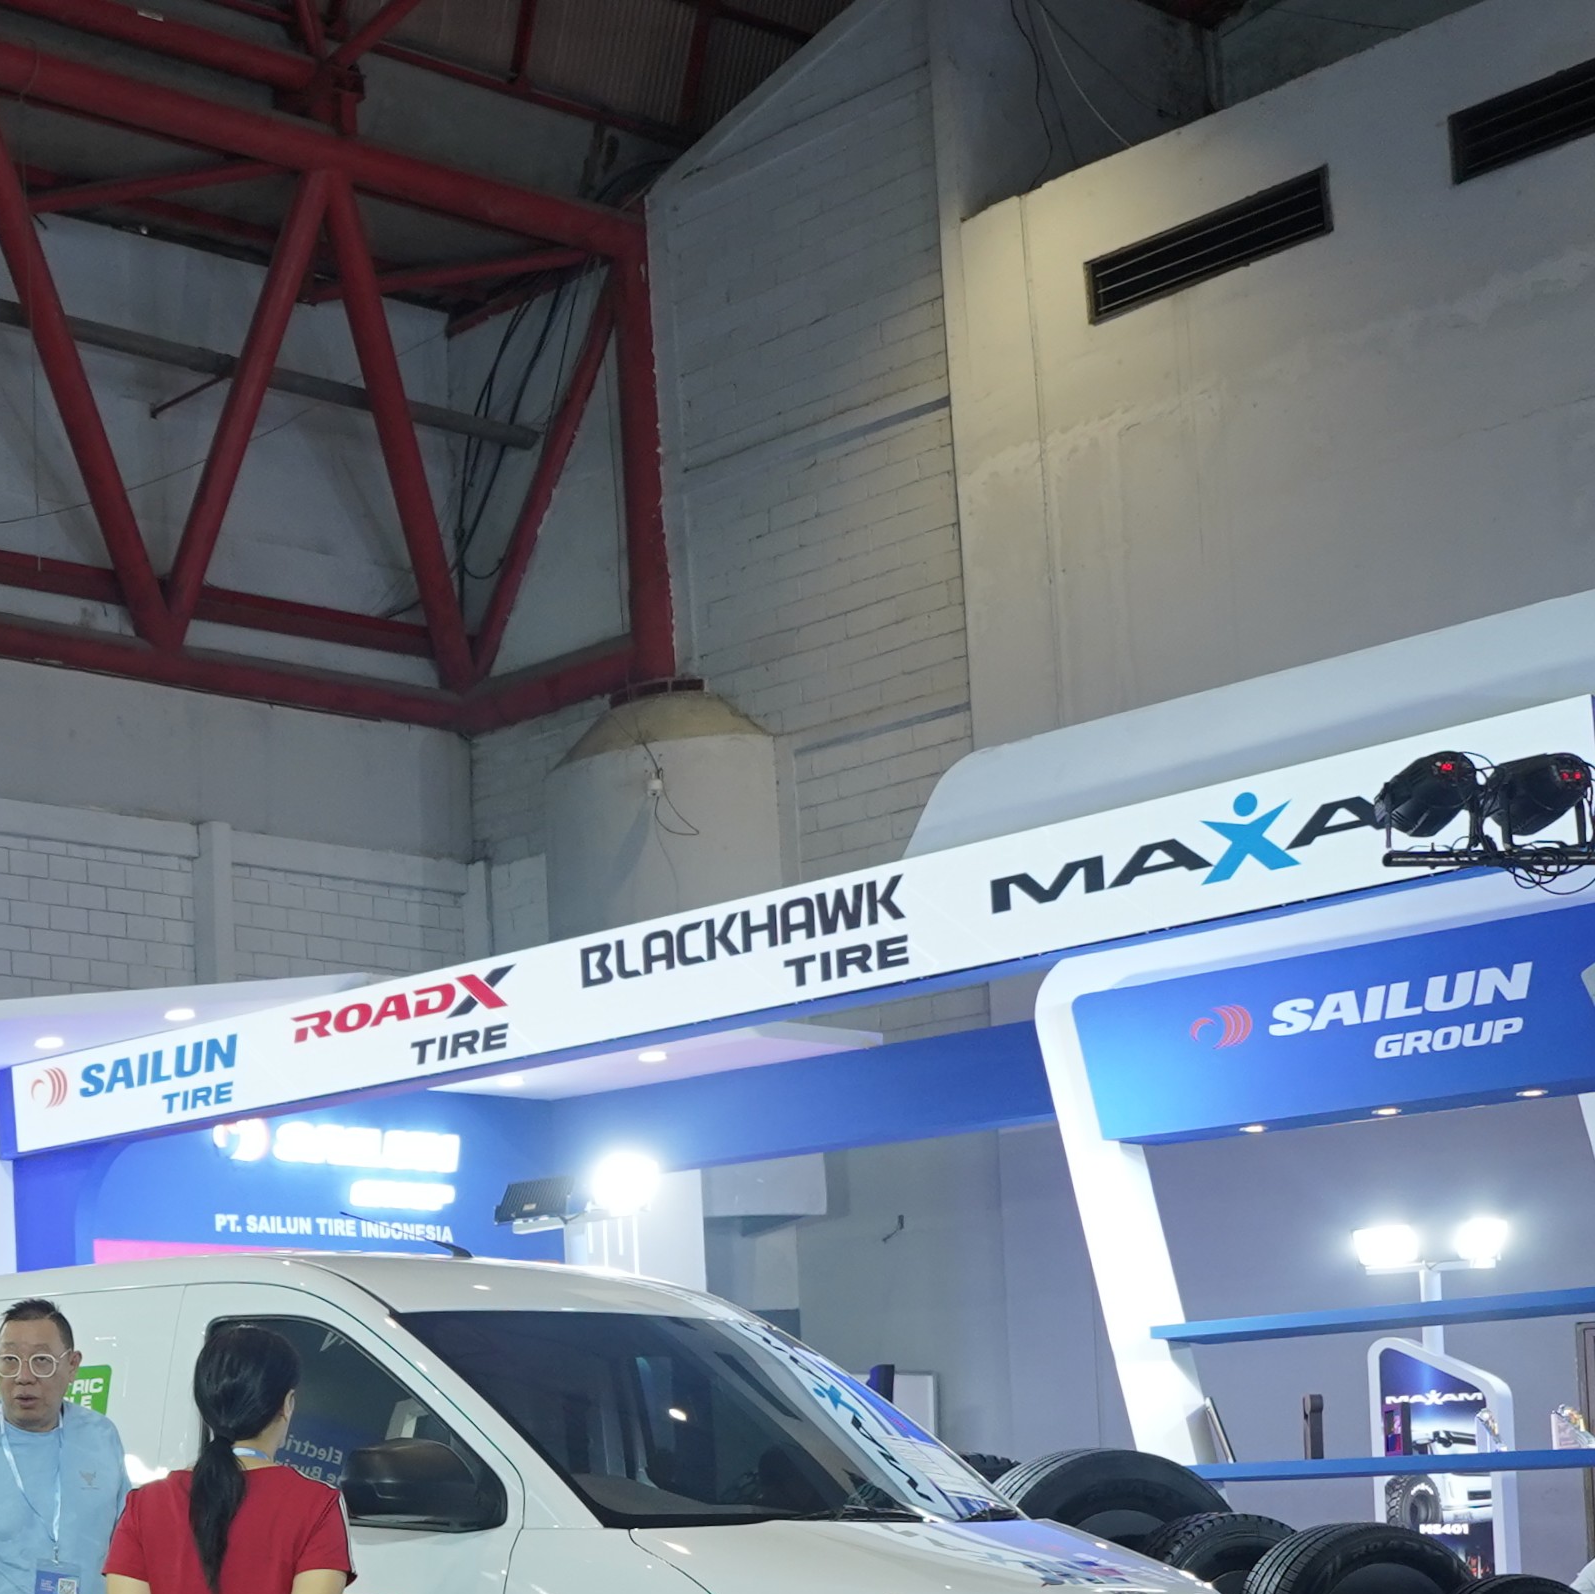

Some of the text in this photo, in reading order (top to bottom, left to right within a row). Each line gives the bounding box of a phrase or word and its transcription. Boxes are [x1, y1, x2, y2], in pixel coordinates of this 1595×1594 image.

[580, 873, 906, 987] BLACKHAWK
[784, 935, 910, 987] TIRE
[292, 964, 515, 1043] ROADX
[1269, 962, 1533, 1037] SAILUN
[411, 1023, 509, 1065] TIRE
[1374, 1017, 1524, 1060] GROUP
[78, 1033, 238, 1099] SAILUN
[161, 1081, 233, 1115] TIRE
[215, 1213, 454, 1243] PT. SAILUN TIRE INDONESIA
[1385, 1390, 1483, 1406] MAXAM
